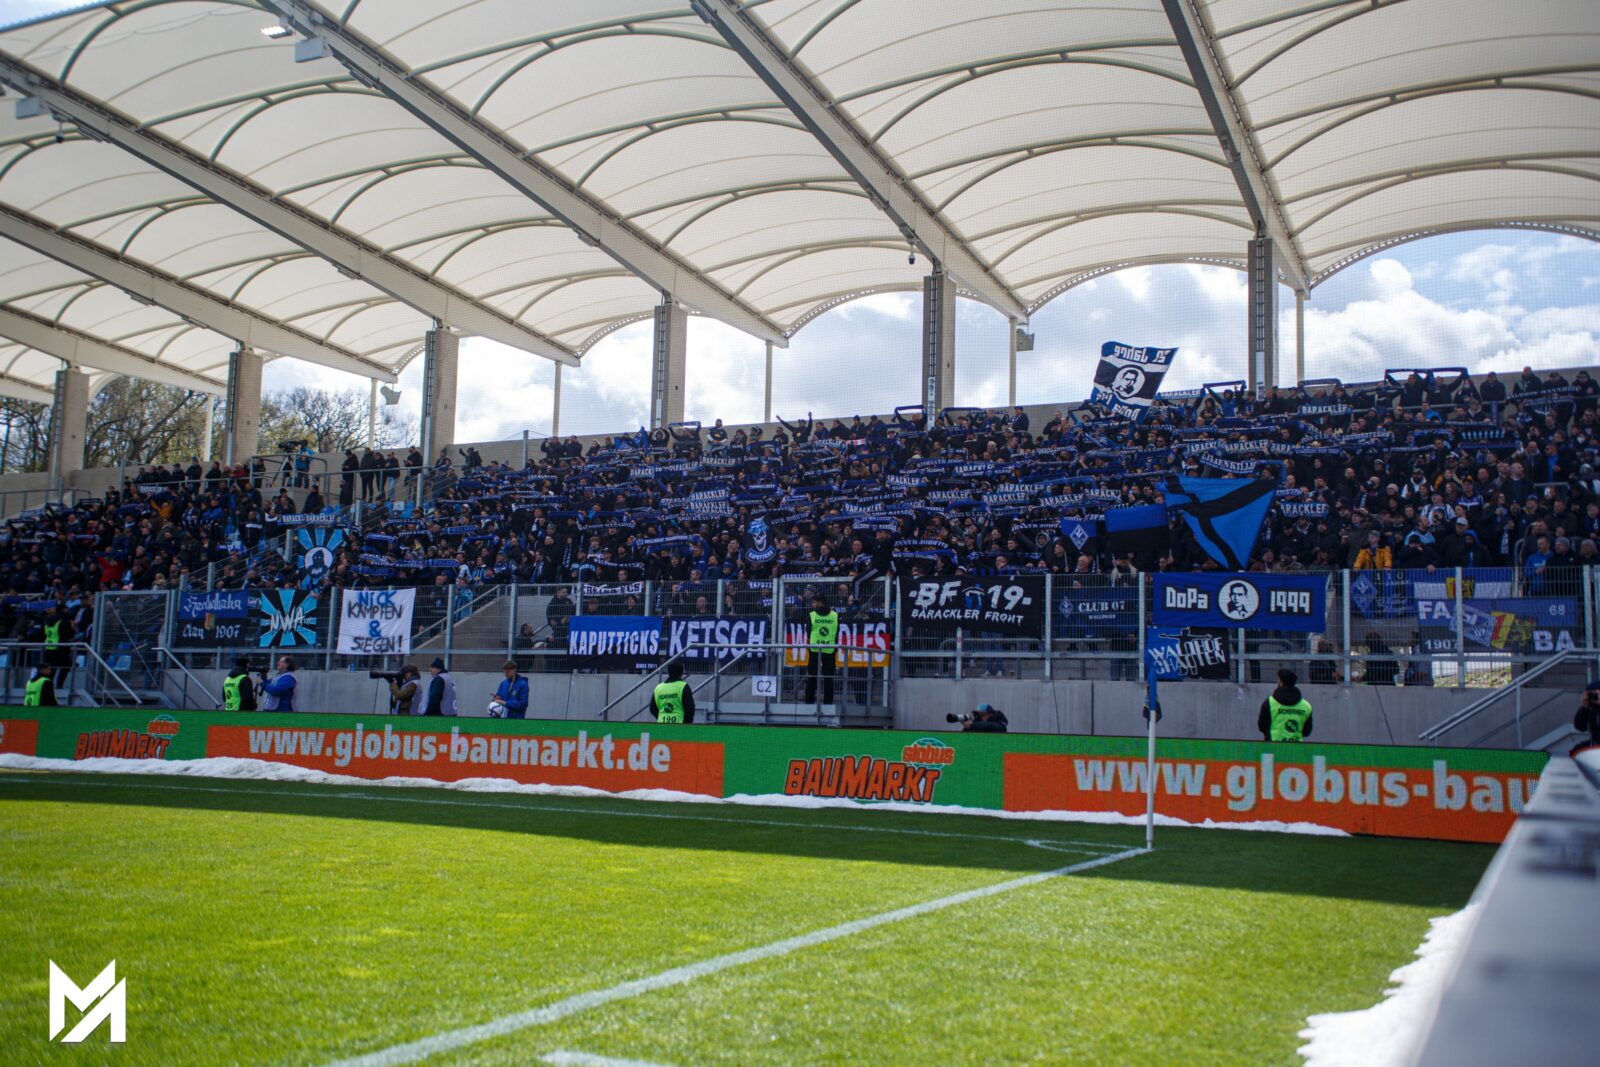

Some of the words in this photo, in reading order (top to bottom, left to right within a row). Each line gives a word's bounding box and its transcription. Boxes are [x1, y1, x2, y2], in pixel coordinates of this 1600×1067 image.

[1270, 590, 1311, 613] 1999
[911, 609, 980, 619] BARACKLER
[984, 611, 1024, 625] FRONT
[1549, 605, 1566, 615] 68
[215, 624, 241, 639] 1907
[368, 621, 382, 637] &
[669, 620, 766, 660] KETSCH
[757, 681, 772, 693] C2
[662, 716, 677, 724] 190
[74, 729, 170, 761] BAUMARKT
[248, 723, 671, 772] www.globus-baumarkt.de
[785, 756, 941, 803] BAUMARKT
